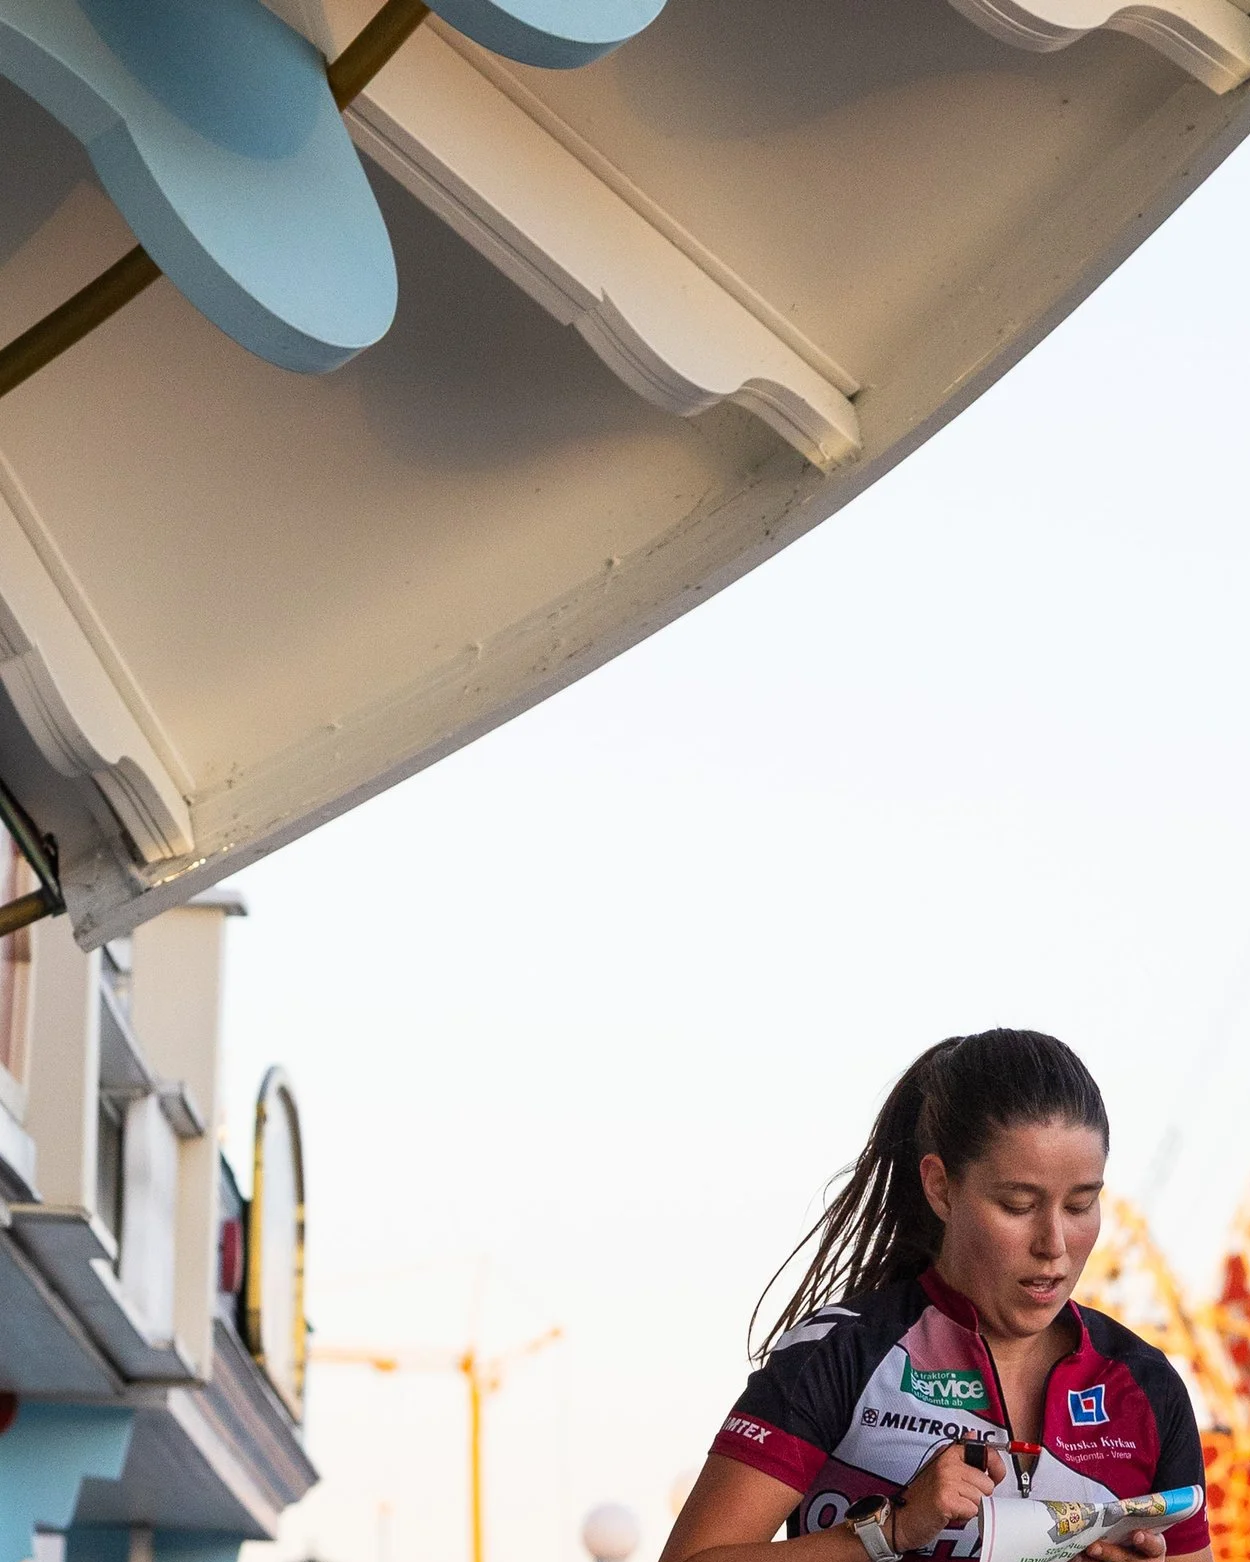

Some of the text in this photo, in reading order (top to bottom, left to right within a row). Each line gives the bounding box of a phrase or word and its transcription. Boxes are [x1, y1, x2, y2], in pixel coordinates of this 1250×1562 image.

[920, 1372, 950, 1380] traktor
[911, 1374, 984, 1399] service
[1056, 1435, 1137, 1452] Svenska Kyrkan
